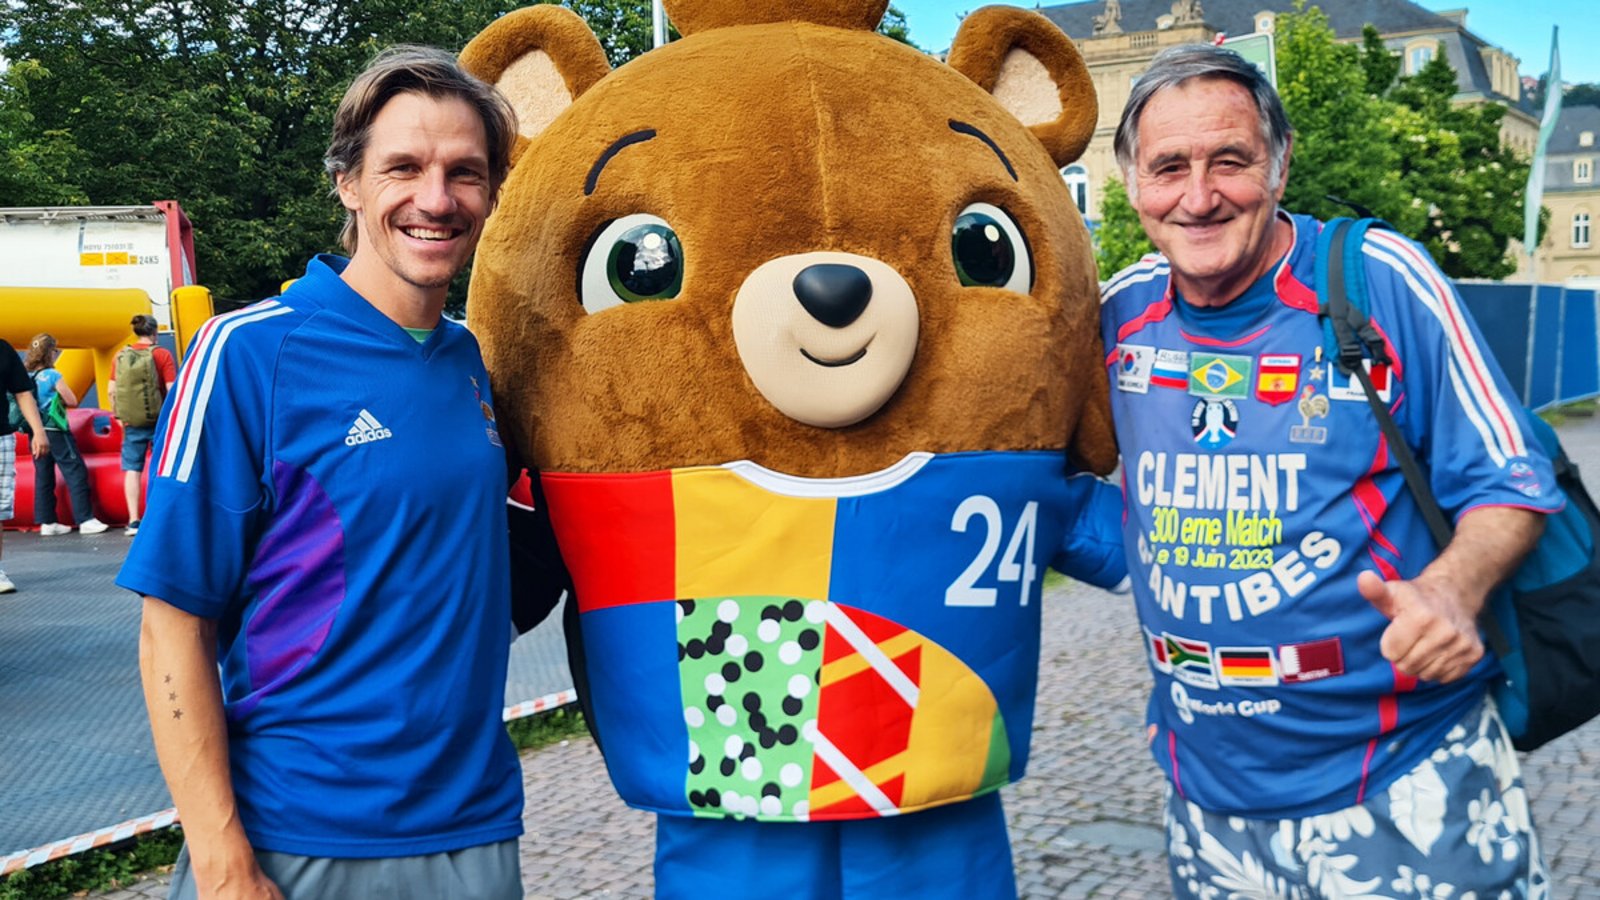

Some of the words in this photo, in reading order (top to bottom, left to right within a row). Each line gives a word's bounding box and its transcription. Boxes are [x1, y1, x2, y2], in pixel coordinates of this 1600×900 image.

[345, 427, 392, 446] adidas
[1137, 451, 1306, 511] CLEMENT
[1149, 506, 1179, 544] 300
[1226, 508, 1283, 547] Match
[944, 494, 1039, 607] 24
[1173, 546, 1190, 566] 19
[1191, 547, 1227, 568] Juin
[1228, 548, 1274, 570] 2023
